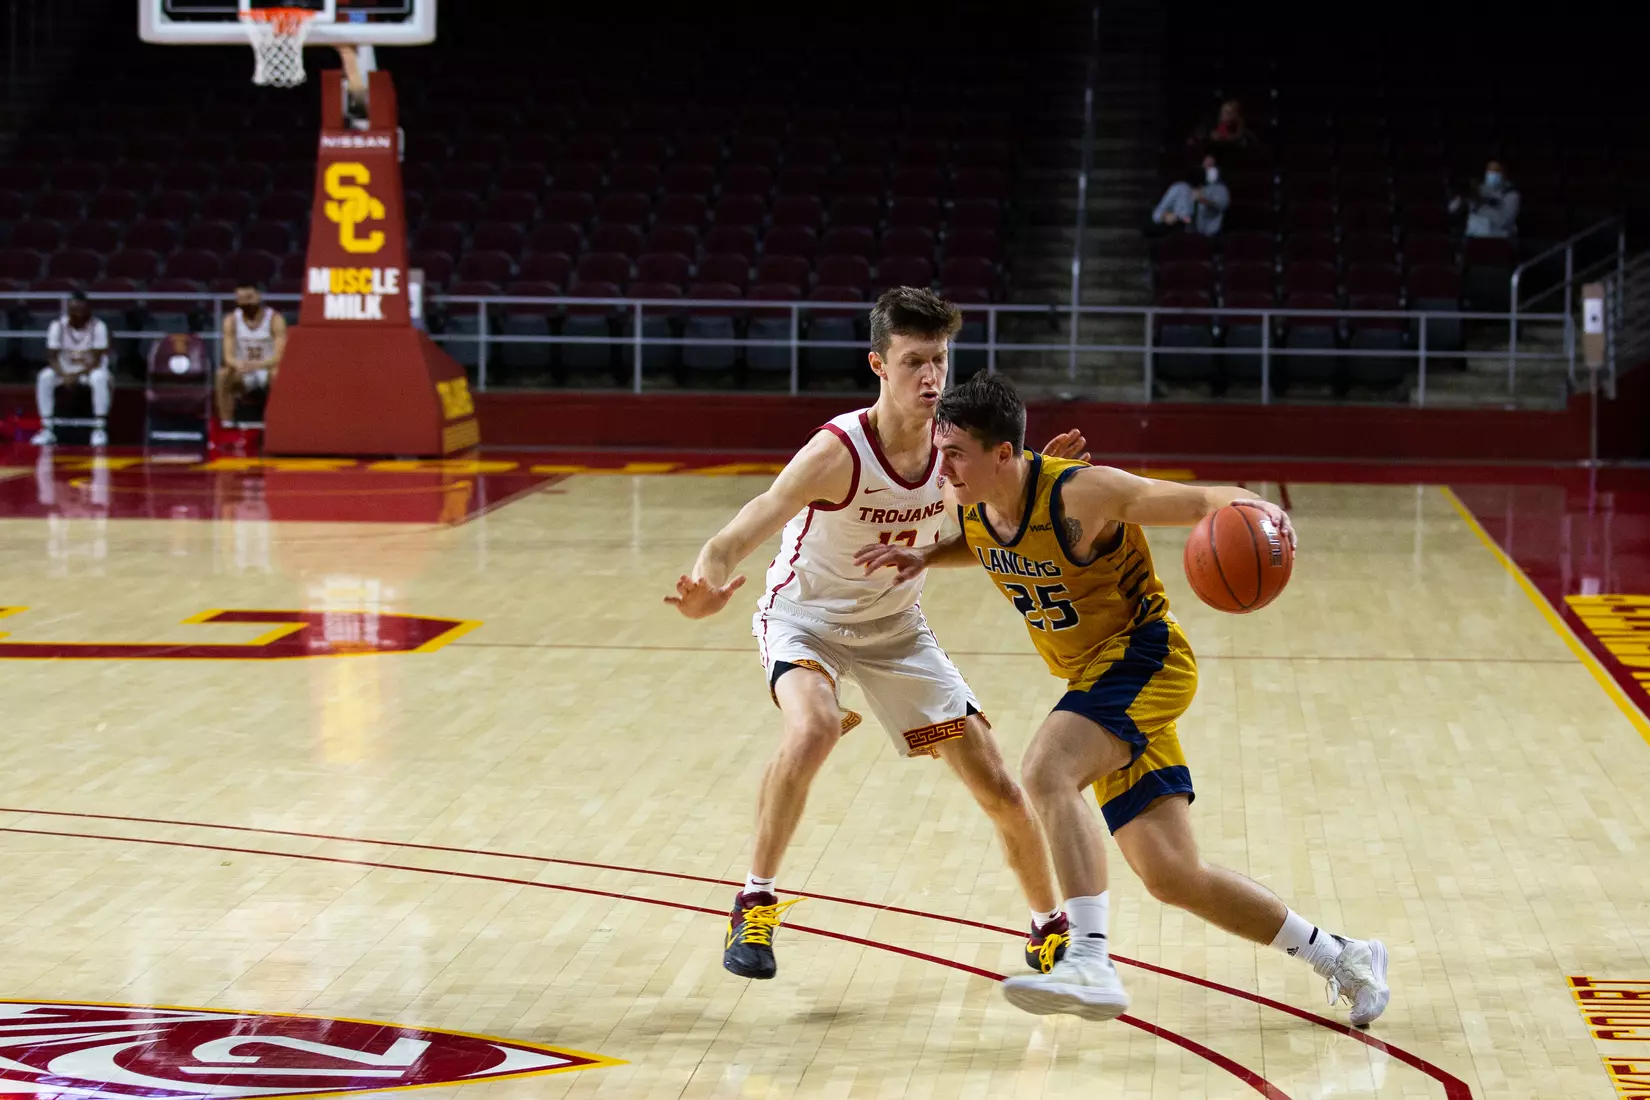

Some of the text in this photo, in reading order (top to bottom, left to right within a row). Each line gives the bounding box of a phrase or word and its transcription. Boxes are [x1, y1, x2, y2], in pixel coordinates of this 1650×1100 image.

[321, 136, 391, 148] NISSAN
[308, 267, 400, 294] MUSCLE
[323, 295, 384, 320] MILK
[859, 500, 945, 523] TROJANS
[1029, 523, 1053, 532] WAC
[1000, 582, 1080, 632] 25
